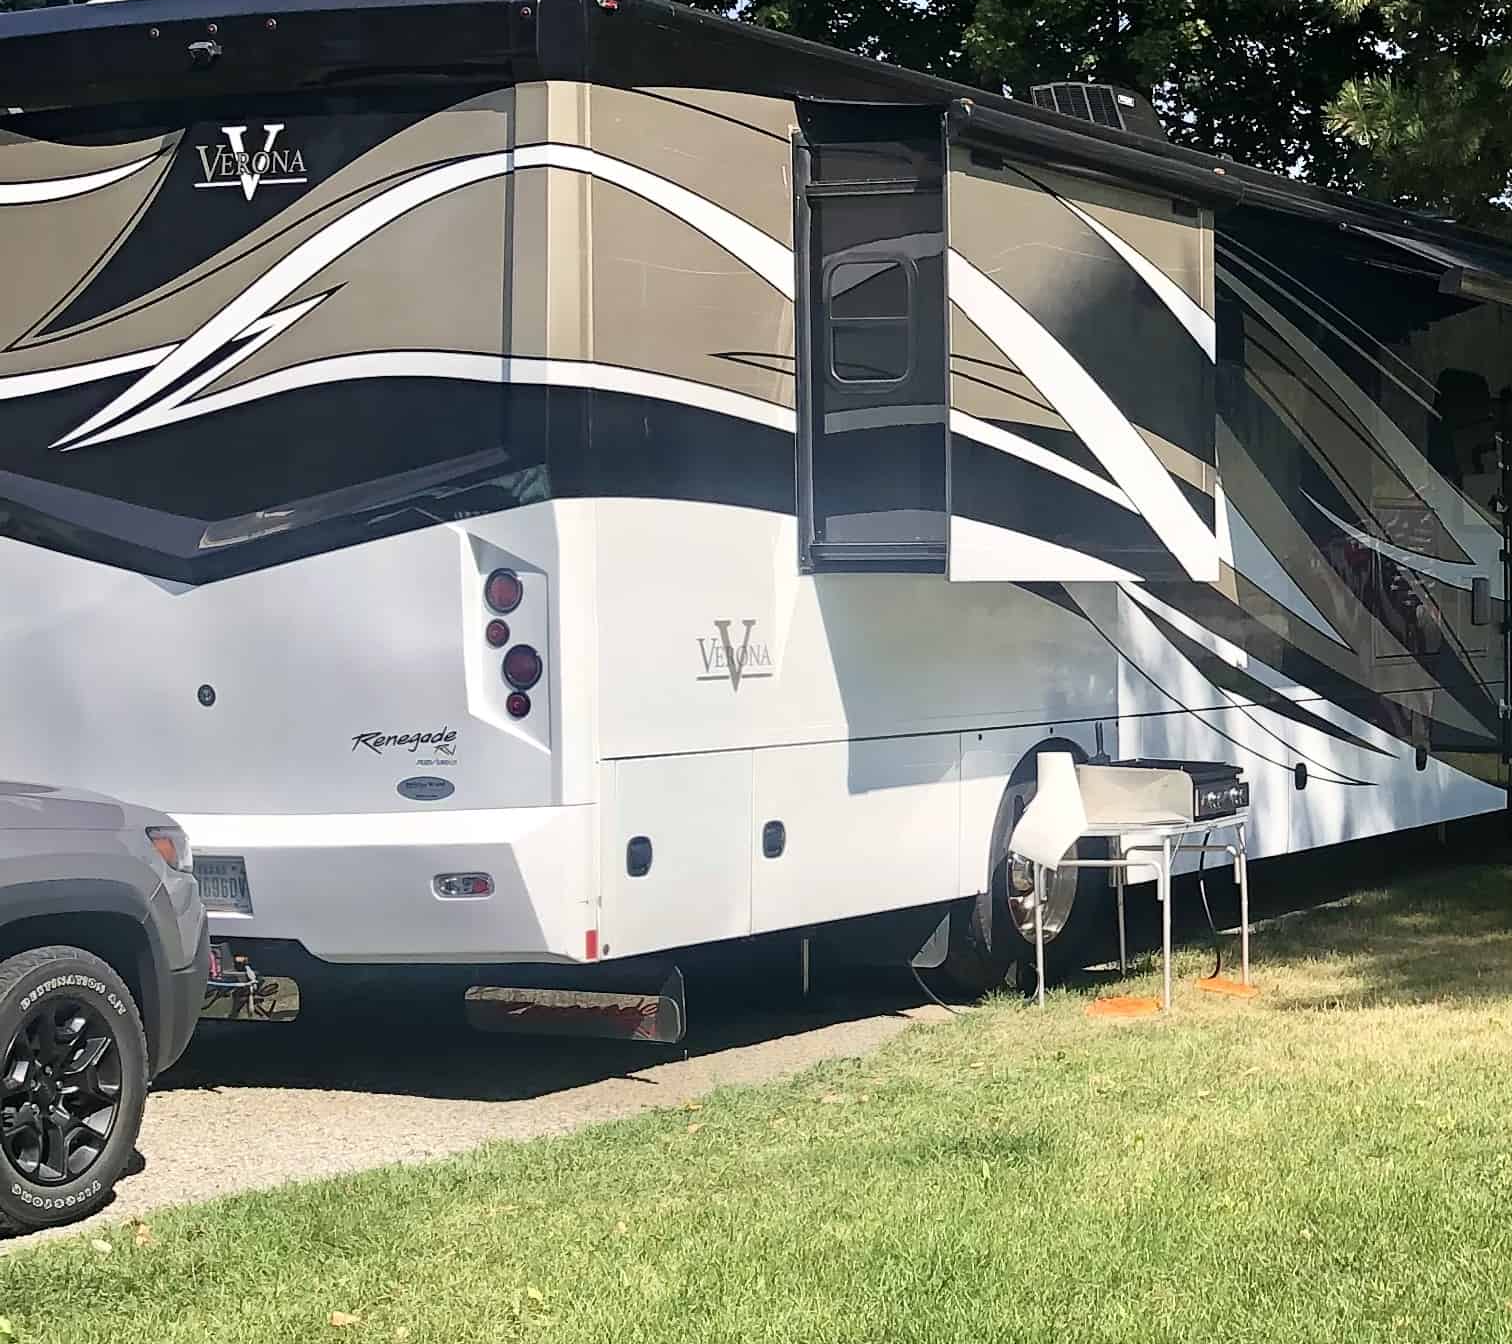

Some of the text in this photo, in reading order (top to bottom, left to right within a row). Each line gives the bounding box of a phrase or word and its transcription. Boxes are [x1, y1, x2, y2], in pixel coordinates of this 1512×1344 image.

[195, 144, 307, 183] VERONA
[696, 638, 773, 673] VERONA
[352, 725, 457, 755] Renegade
